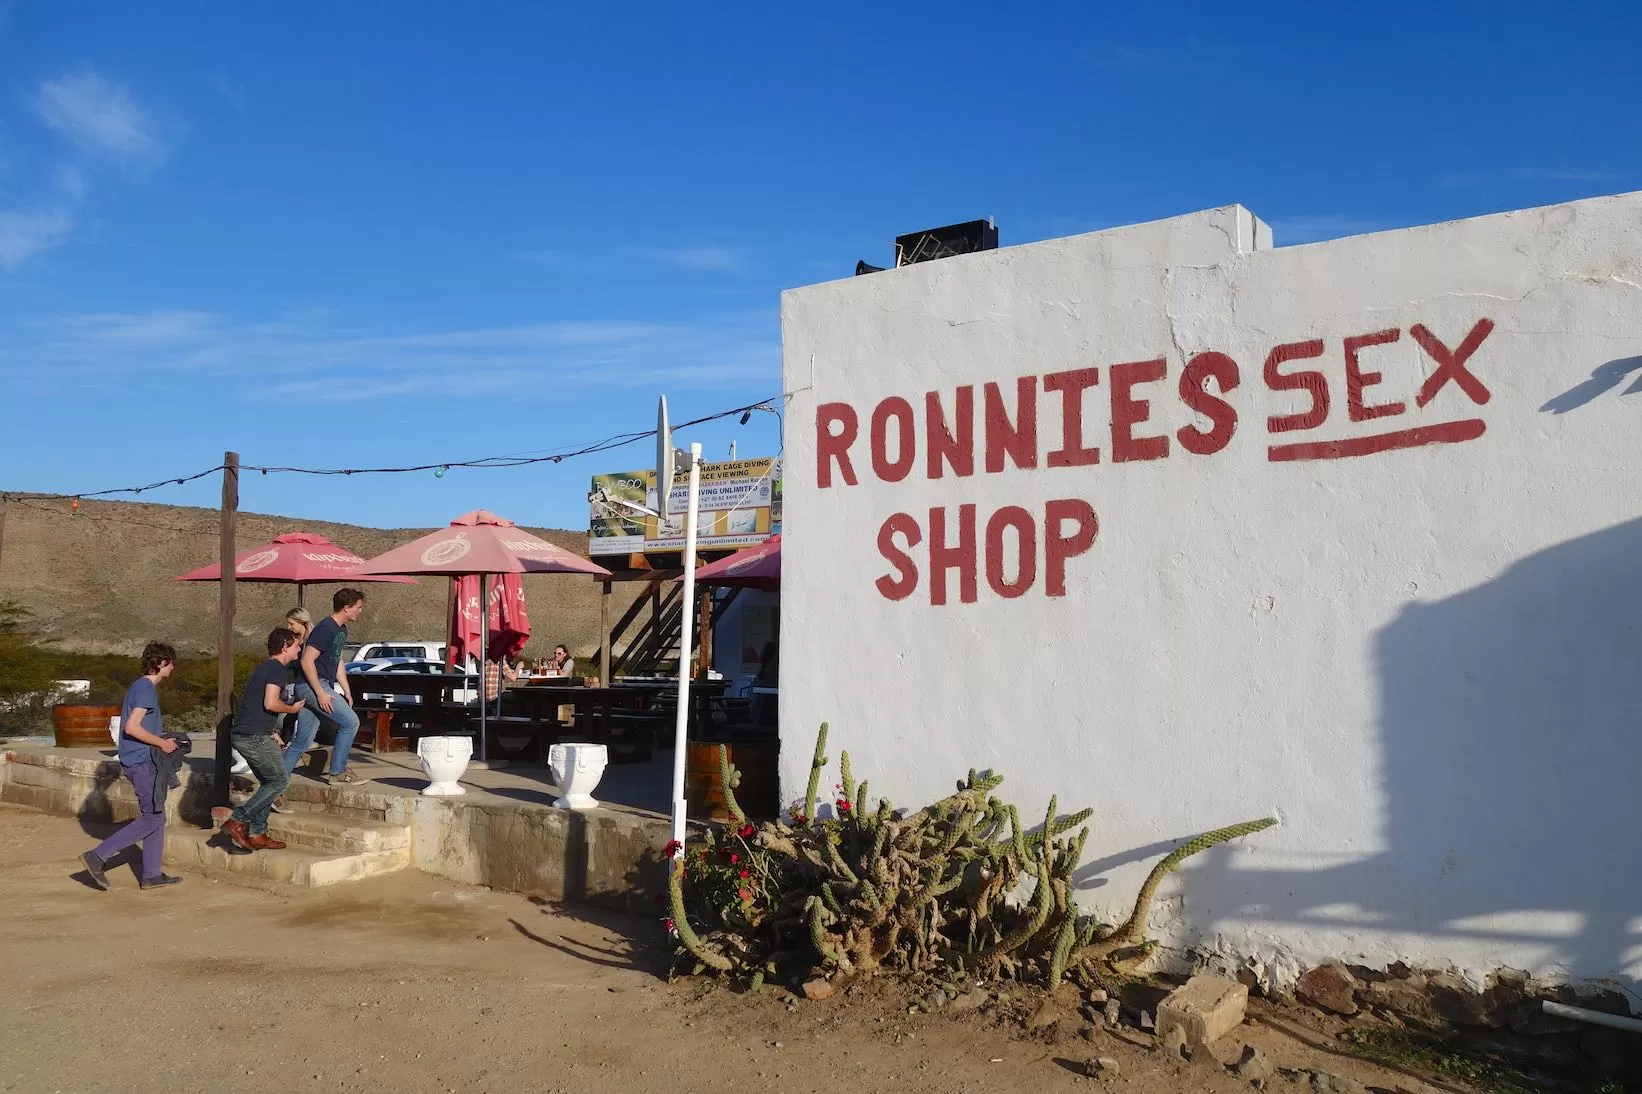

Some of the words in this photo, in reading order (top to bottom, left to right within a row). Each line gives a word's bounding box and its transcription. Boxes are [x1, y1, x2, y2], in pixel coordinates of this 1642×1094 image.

[817, 352, 1237, 488] RONNIES
[1264, 320, 1492, 432] SEX
[700, 464, 720, 473] HARK
[723, 462, 742, 471] CAGE
[744, 459, 769, 468] DIVING
[717, 470, 749, 479] VIEWING
[698, 487, 718, 496] IVING
[876, 499, 1098, 604] SHOP
